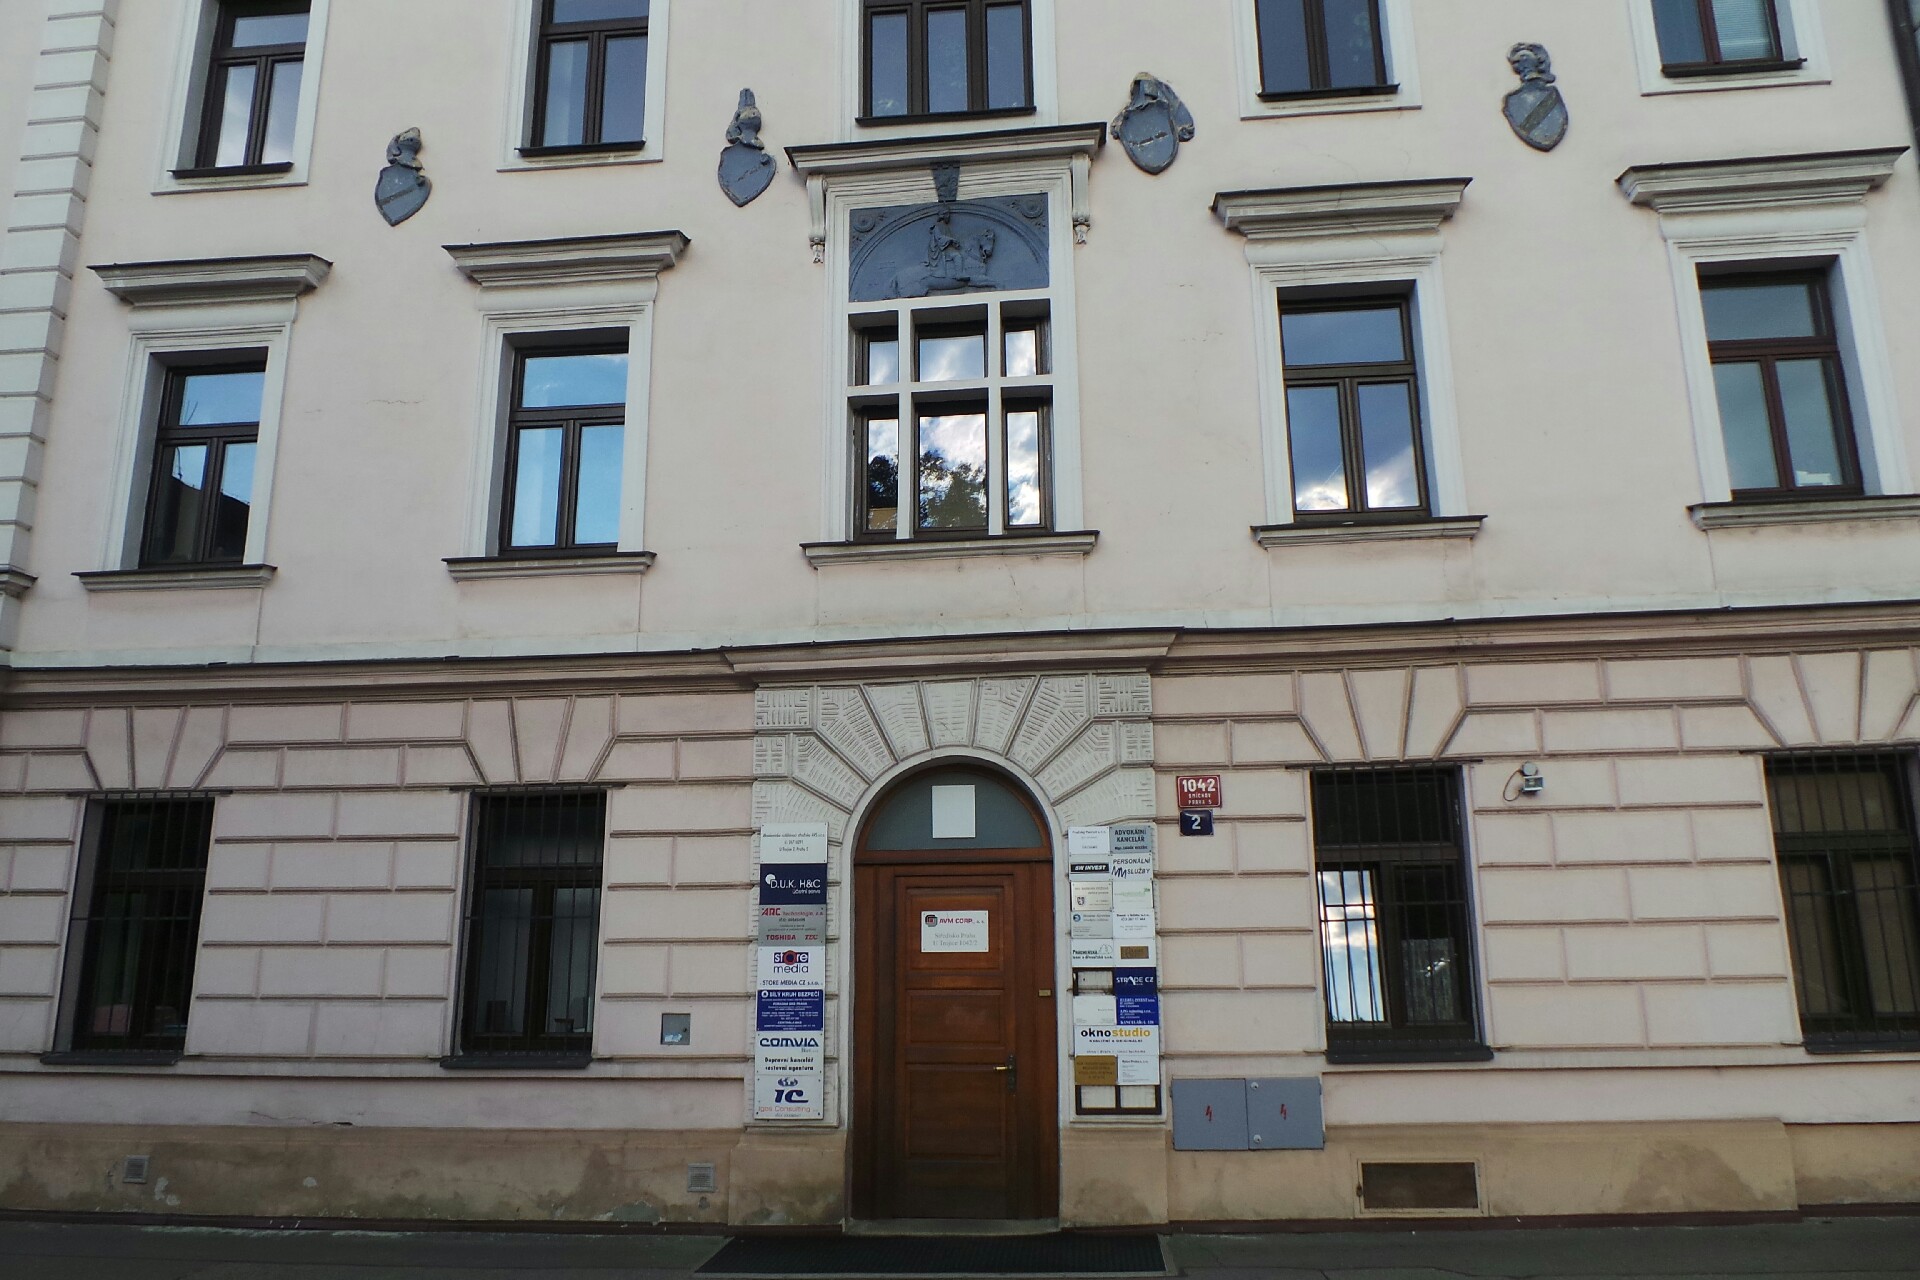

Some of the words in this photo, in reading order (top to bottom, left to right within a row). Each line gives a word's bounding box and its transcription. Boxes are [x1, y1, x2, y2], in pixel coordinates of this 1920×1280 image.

[1182, 778, 1216, 792] 1042
[1191, 815, 1202, 830] 2
[1116, 835, 1145, 843] KANCELÁŘ
[1112, 857, 1151, 865] PERSONÁLNÍ
[1127, 867, 1151, 875] SLUŽBY
[799, 879, 821, 889] H&C
[773, 964, 809, 974] media
[781, 990, 797, 998] KRUH
[1080, 1027, 1151, 1038] oknostudio
